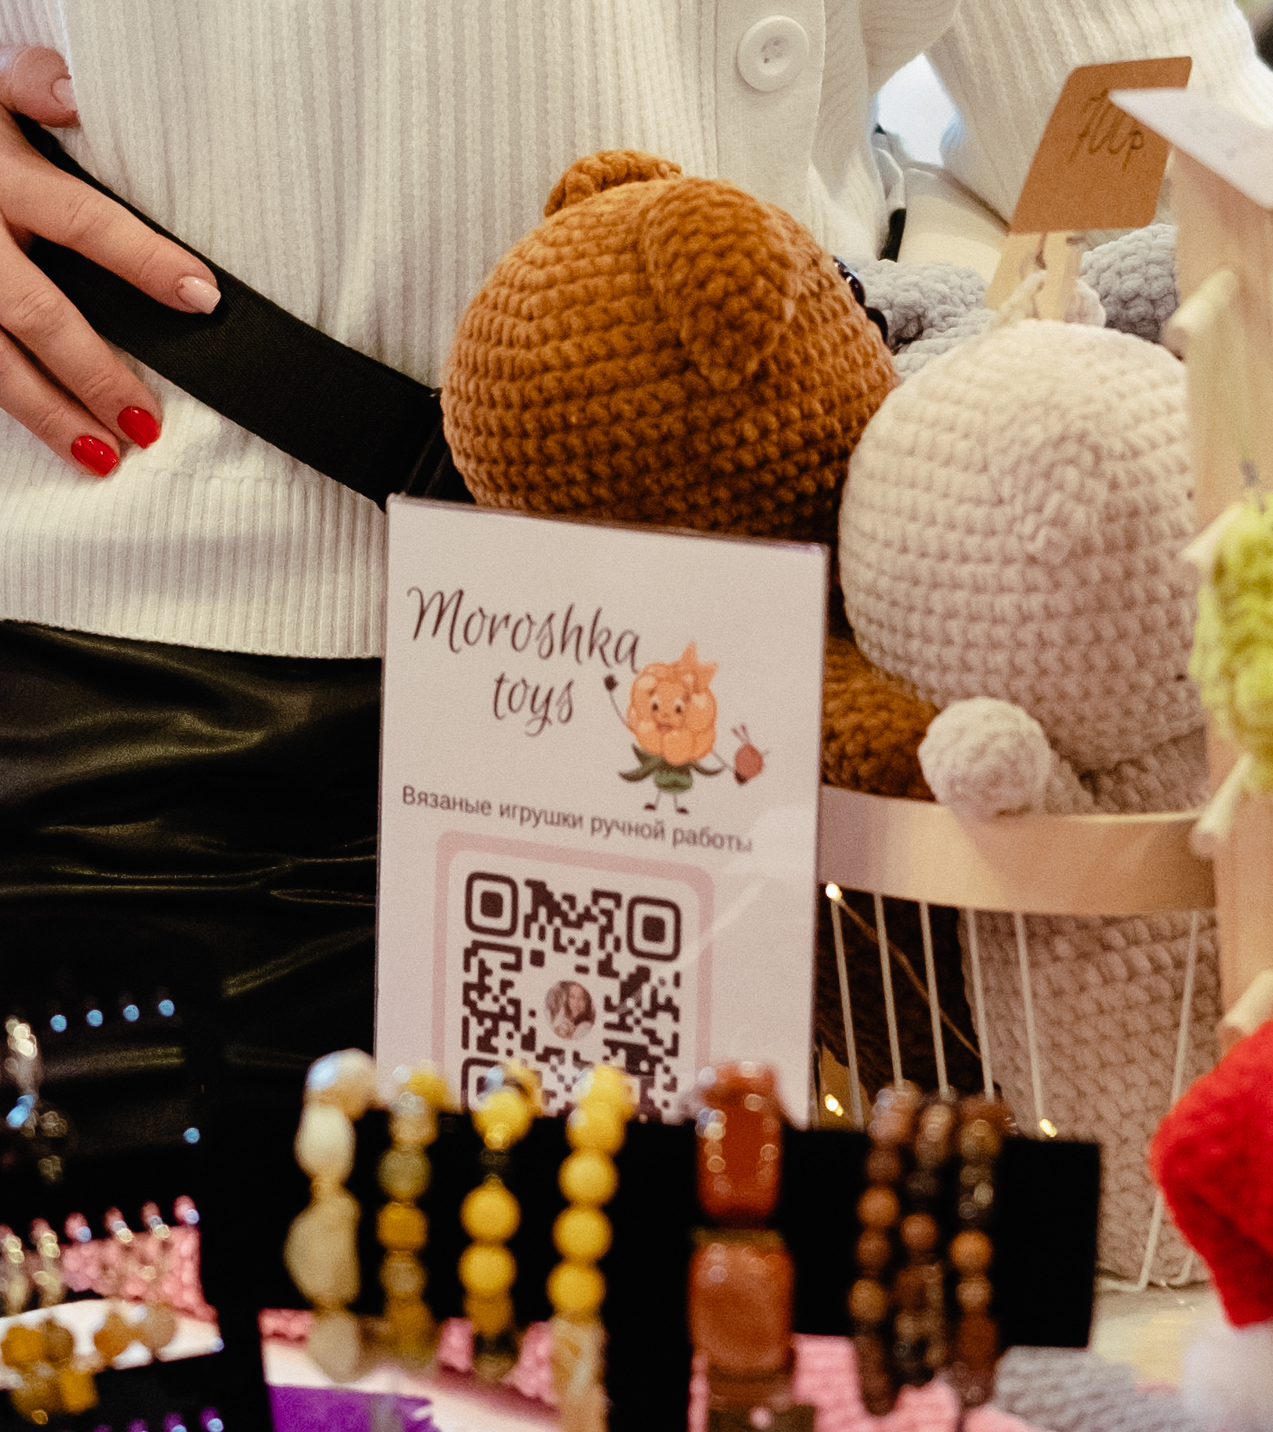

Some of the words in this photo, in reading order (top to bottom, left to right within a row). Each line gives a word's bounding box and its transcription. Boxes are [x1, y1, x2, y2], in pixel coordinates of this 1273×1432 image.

[406, 586, 640, 674] Moroshka
[492, 671, 575, 738] toys
[401, 784, 493, 817] Вязаные
[498, 799, 585, 829] игрушки
[590, 815, 666, 841] ручной
[671, 826, 753, 854] работы
